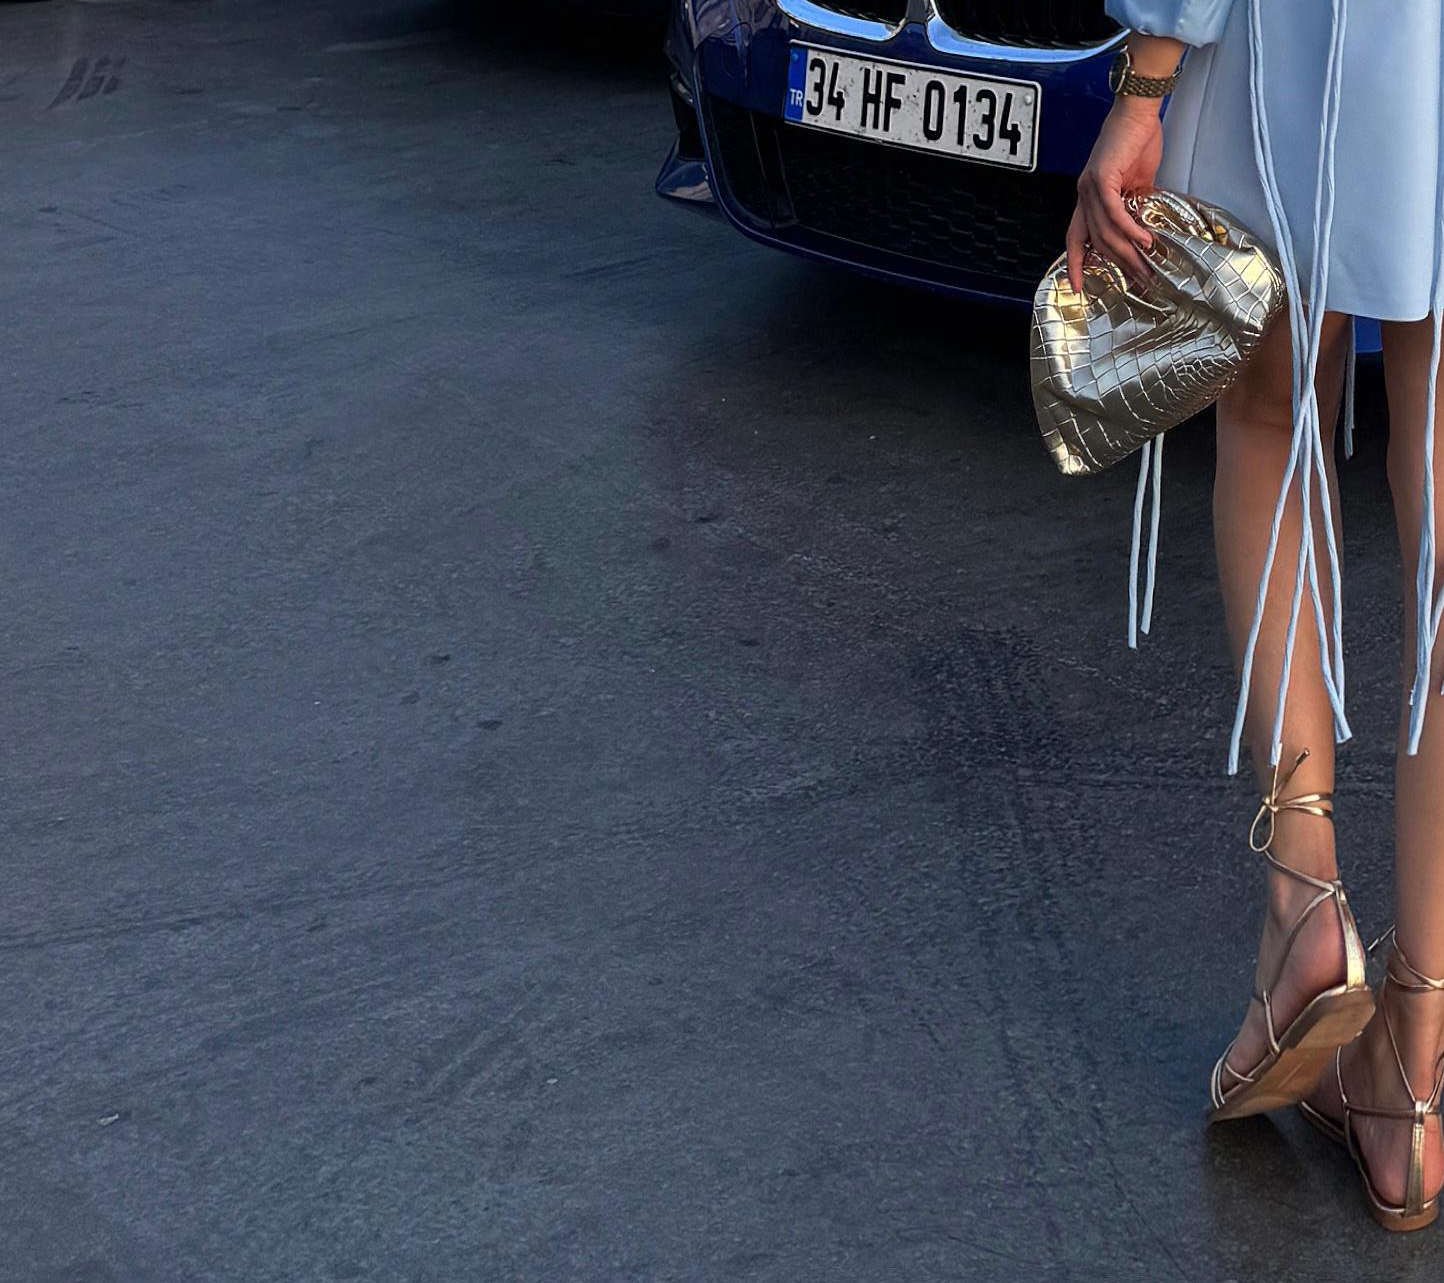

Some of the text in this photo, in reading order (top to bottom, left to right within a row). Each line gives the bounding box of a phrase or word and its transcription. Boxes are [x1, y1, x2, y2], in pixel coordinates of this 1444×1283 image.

[789, 88, 803, 108] TR
[806, 57, 1022, 156] 34 HF 0134
